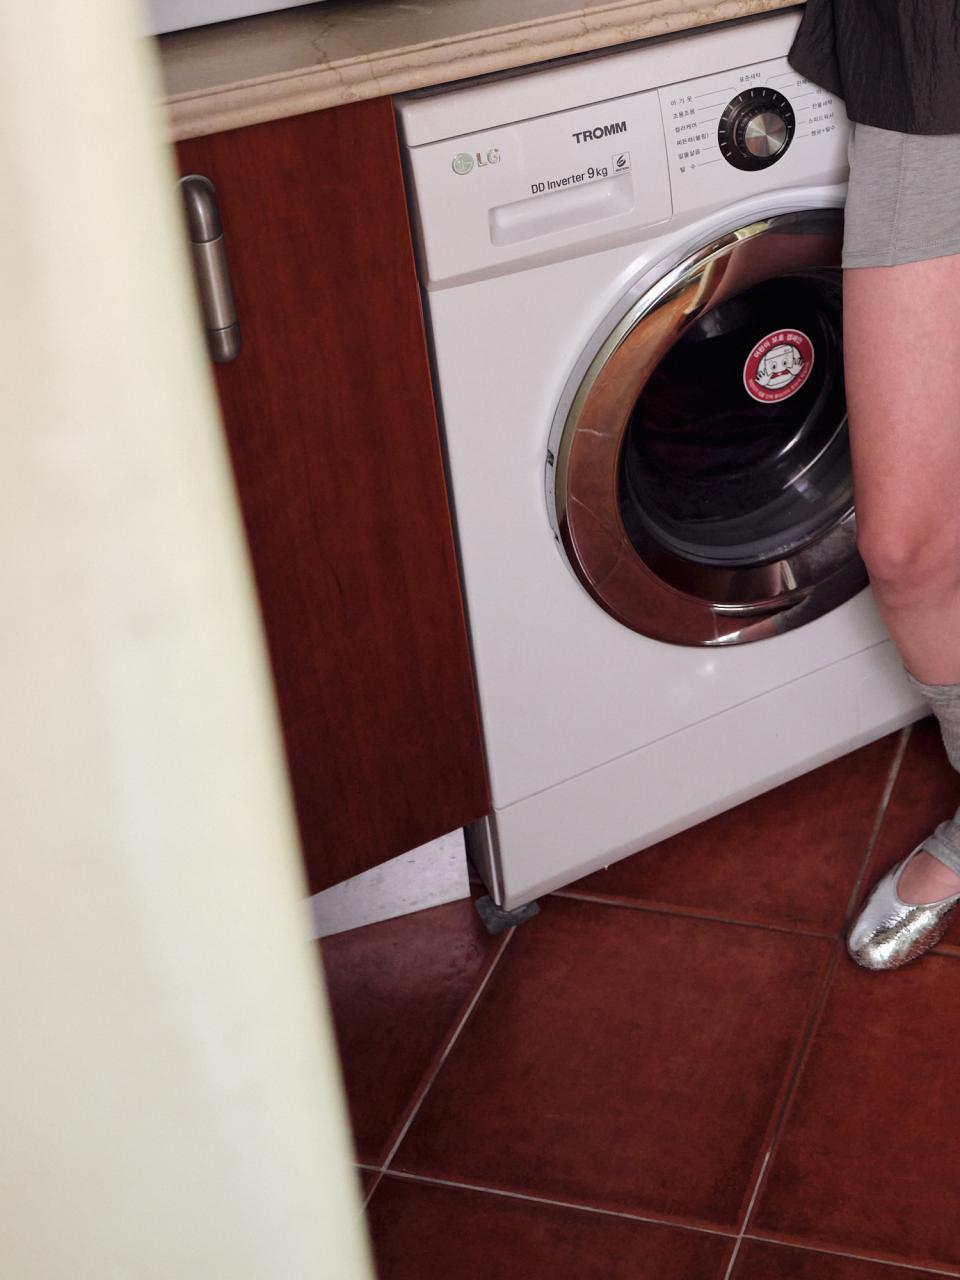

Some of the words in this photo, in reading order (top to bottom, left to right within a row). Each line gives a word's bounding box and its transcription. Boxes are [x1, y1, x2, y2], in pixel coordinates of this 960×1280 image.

[572, 121, 628, 144] TROMM
[476, 148, 501, 168] LG
[531, 182, 546, 194] DD
[547, 173, 586, 190] Inverter
